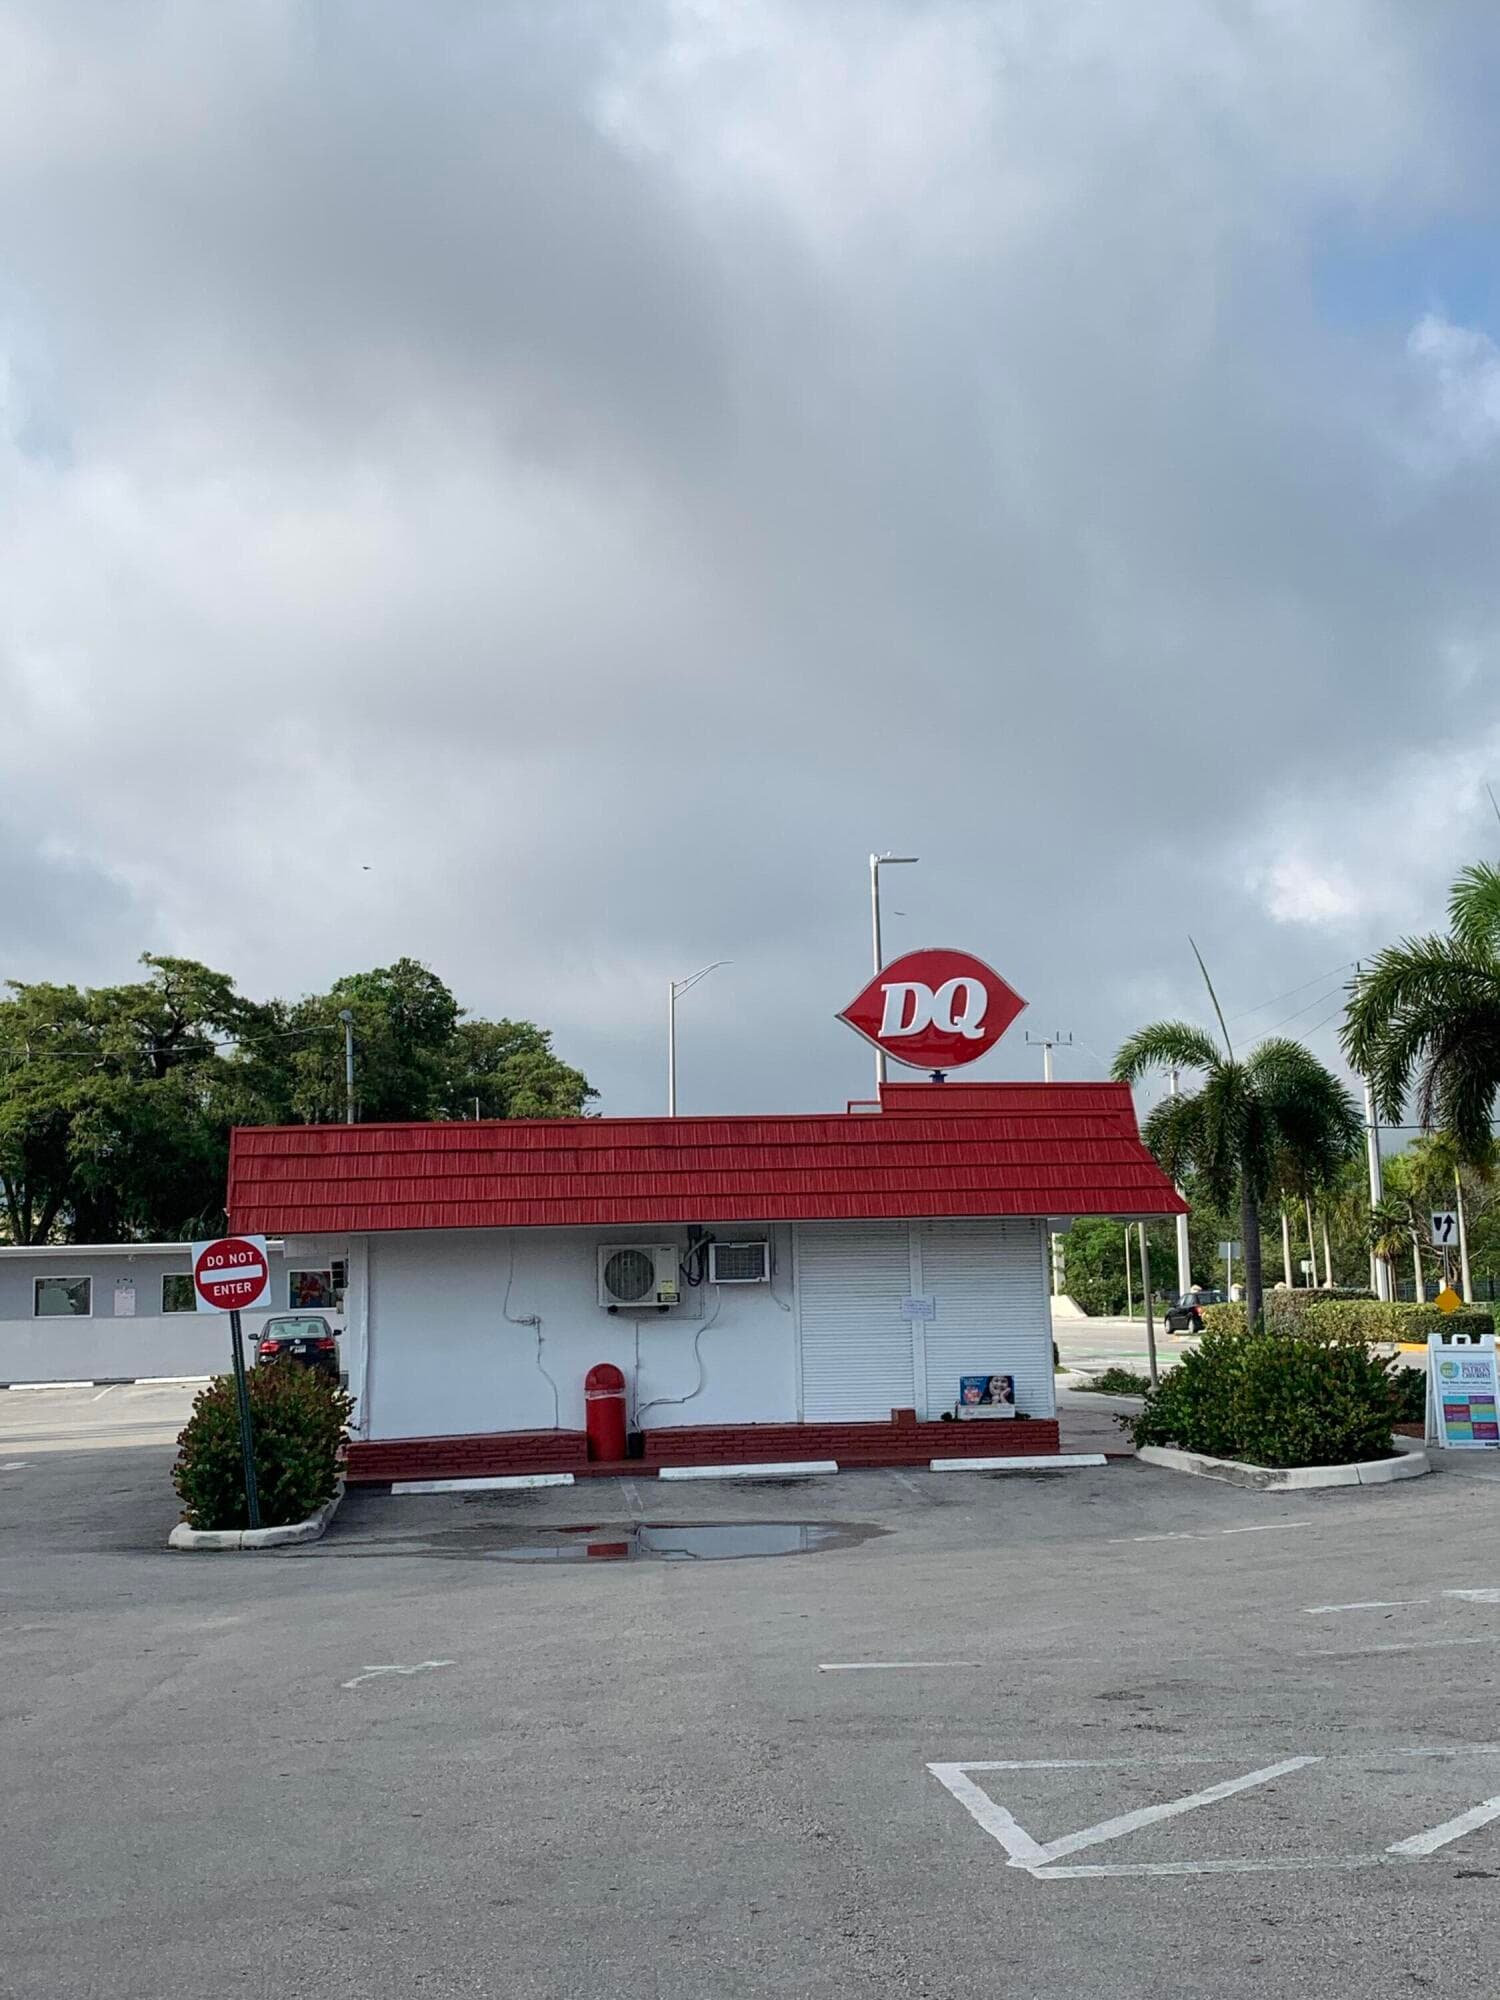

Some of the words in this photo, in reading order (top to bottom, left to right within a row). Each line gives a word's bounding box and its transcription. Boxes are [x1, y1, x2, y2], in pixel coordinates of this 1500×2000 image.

[878, 977, 989, 1040] DQ
[207, 1256, 224, 1267] DO
[229, 1252, 254, 1264] NOT
[213, 1281, 252, 1297] ENTER
